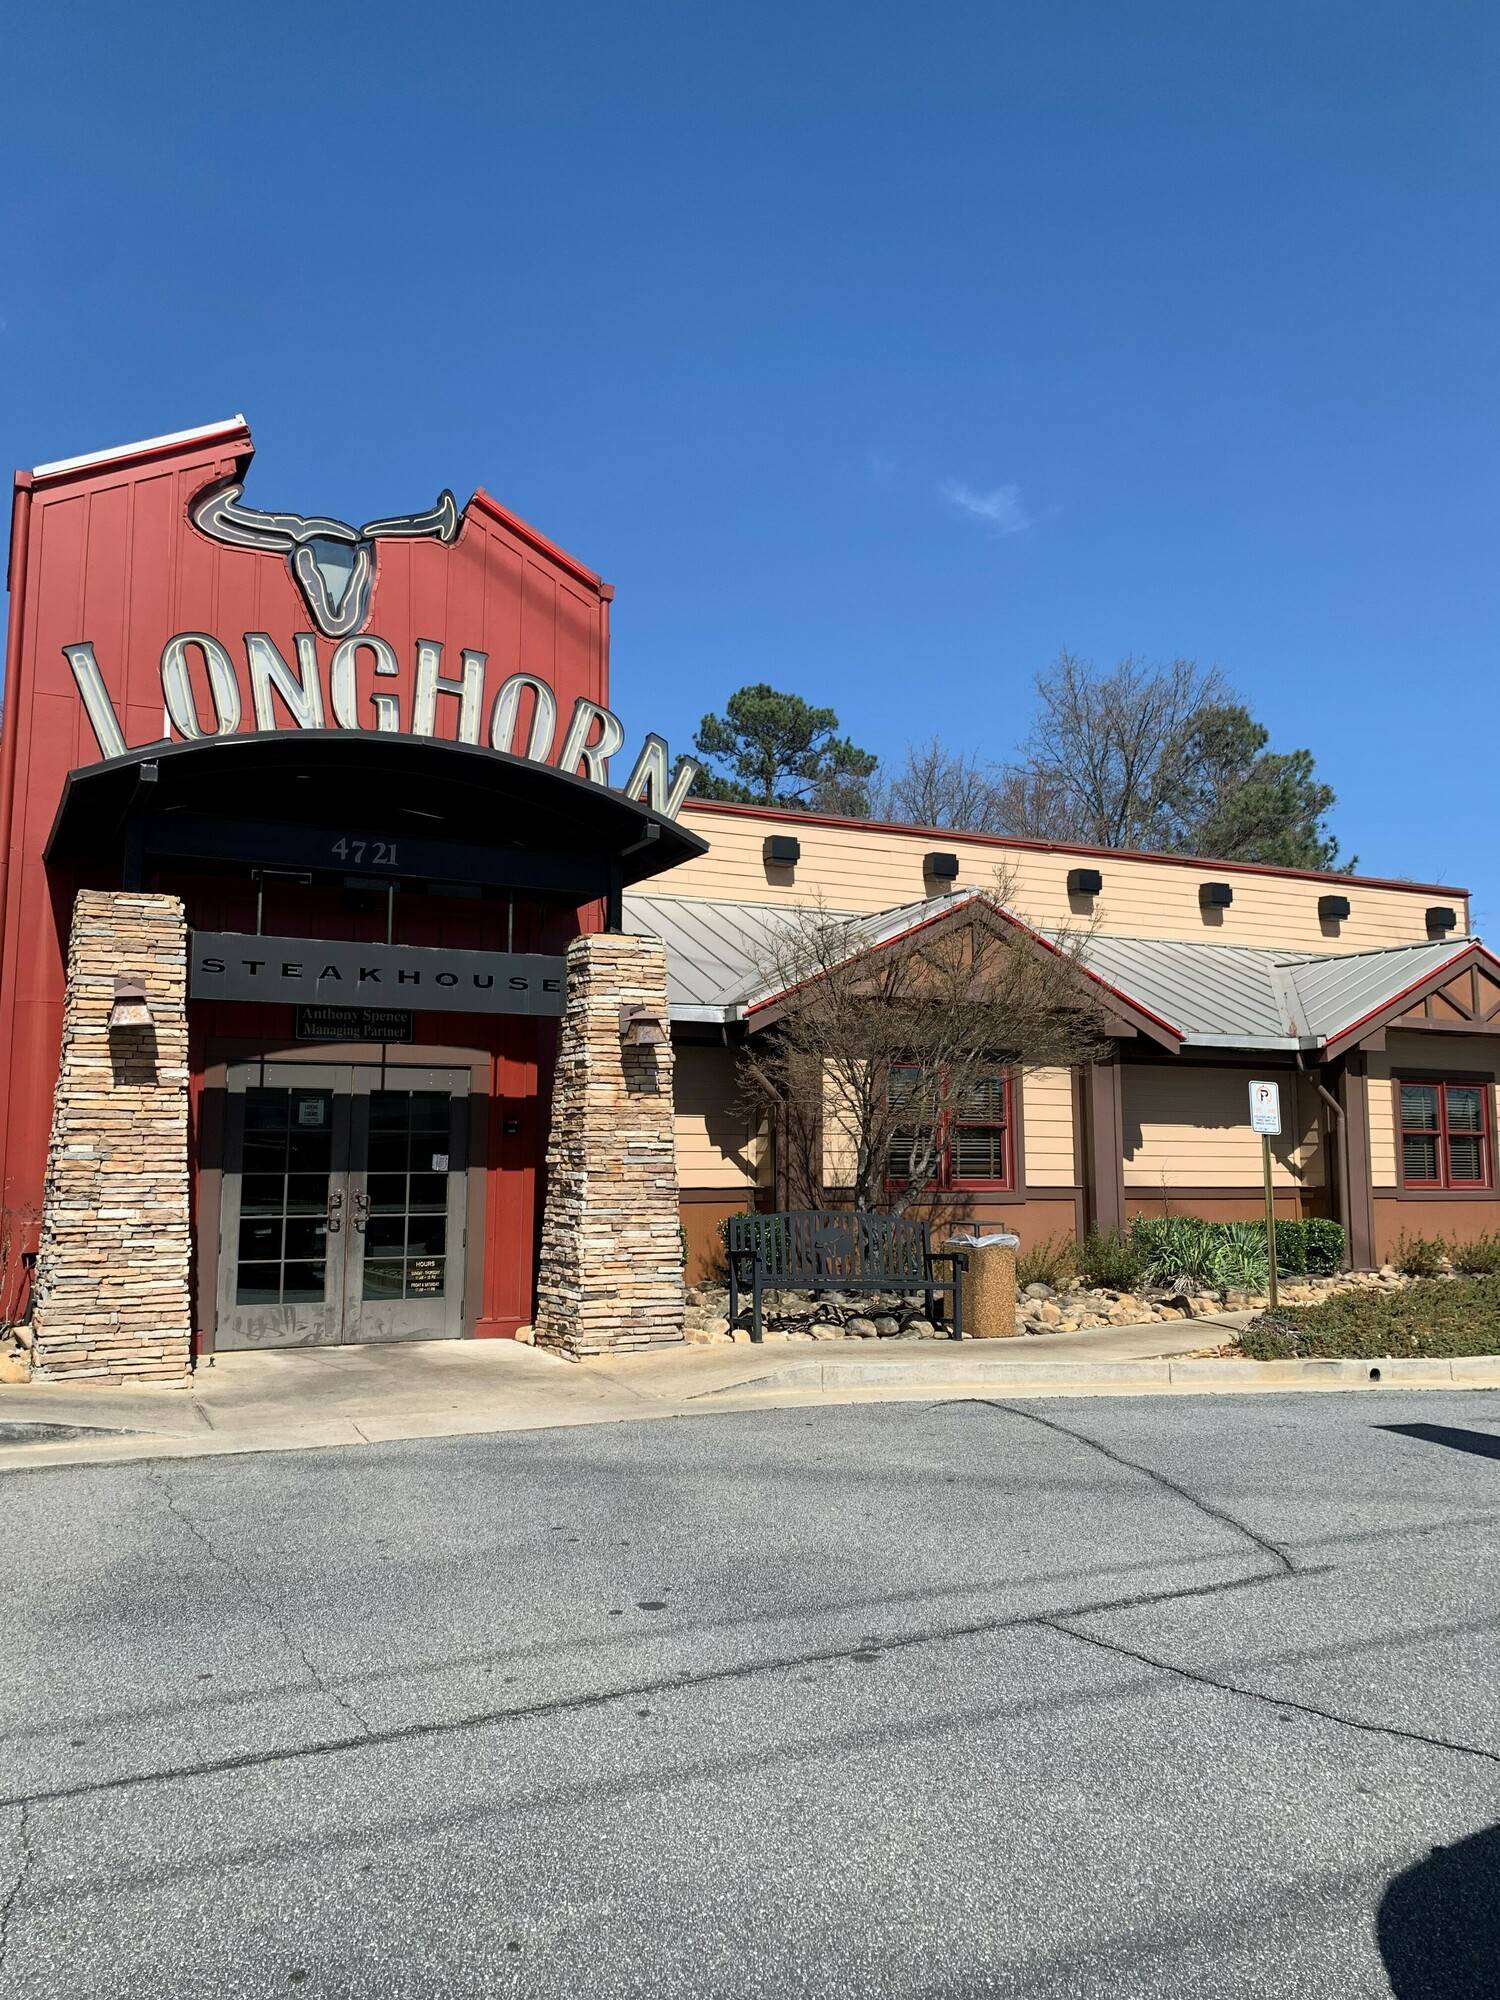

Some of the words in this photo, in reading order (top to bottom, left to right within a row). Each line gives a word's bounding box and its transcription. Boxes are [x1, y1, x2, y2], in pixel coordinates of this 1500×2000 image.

[62, 631, 702, 823] LONGHORN
[331, 837, 400, 866] 4721
[201, 958, 561, 993] STEAKHOUSE
[303, 1007, 360, 1023] Anthony
[363, 1009, 408, 1024] Spence
[303, 1023, 361, 1038] Managing
[364, 1025, 406, 1038] Partner
